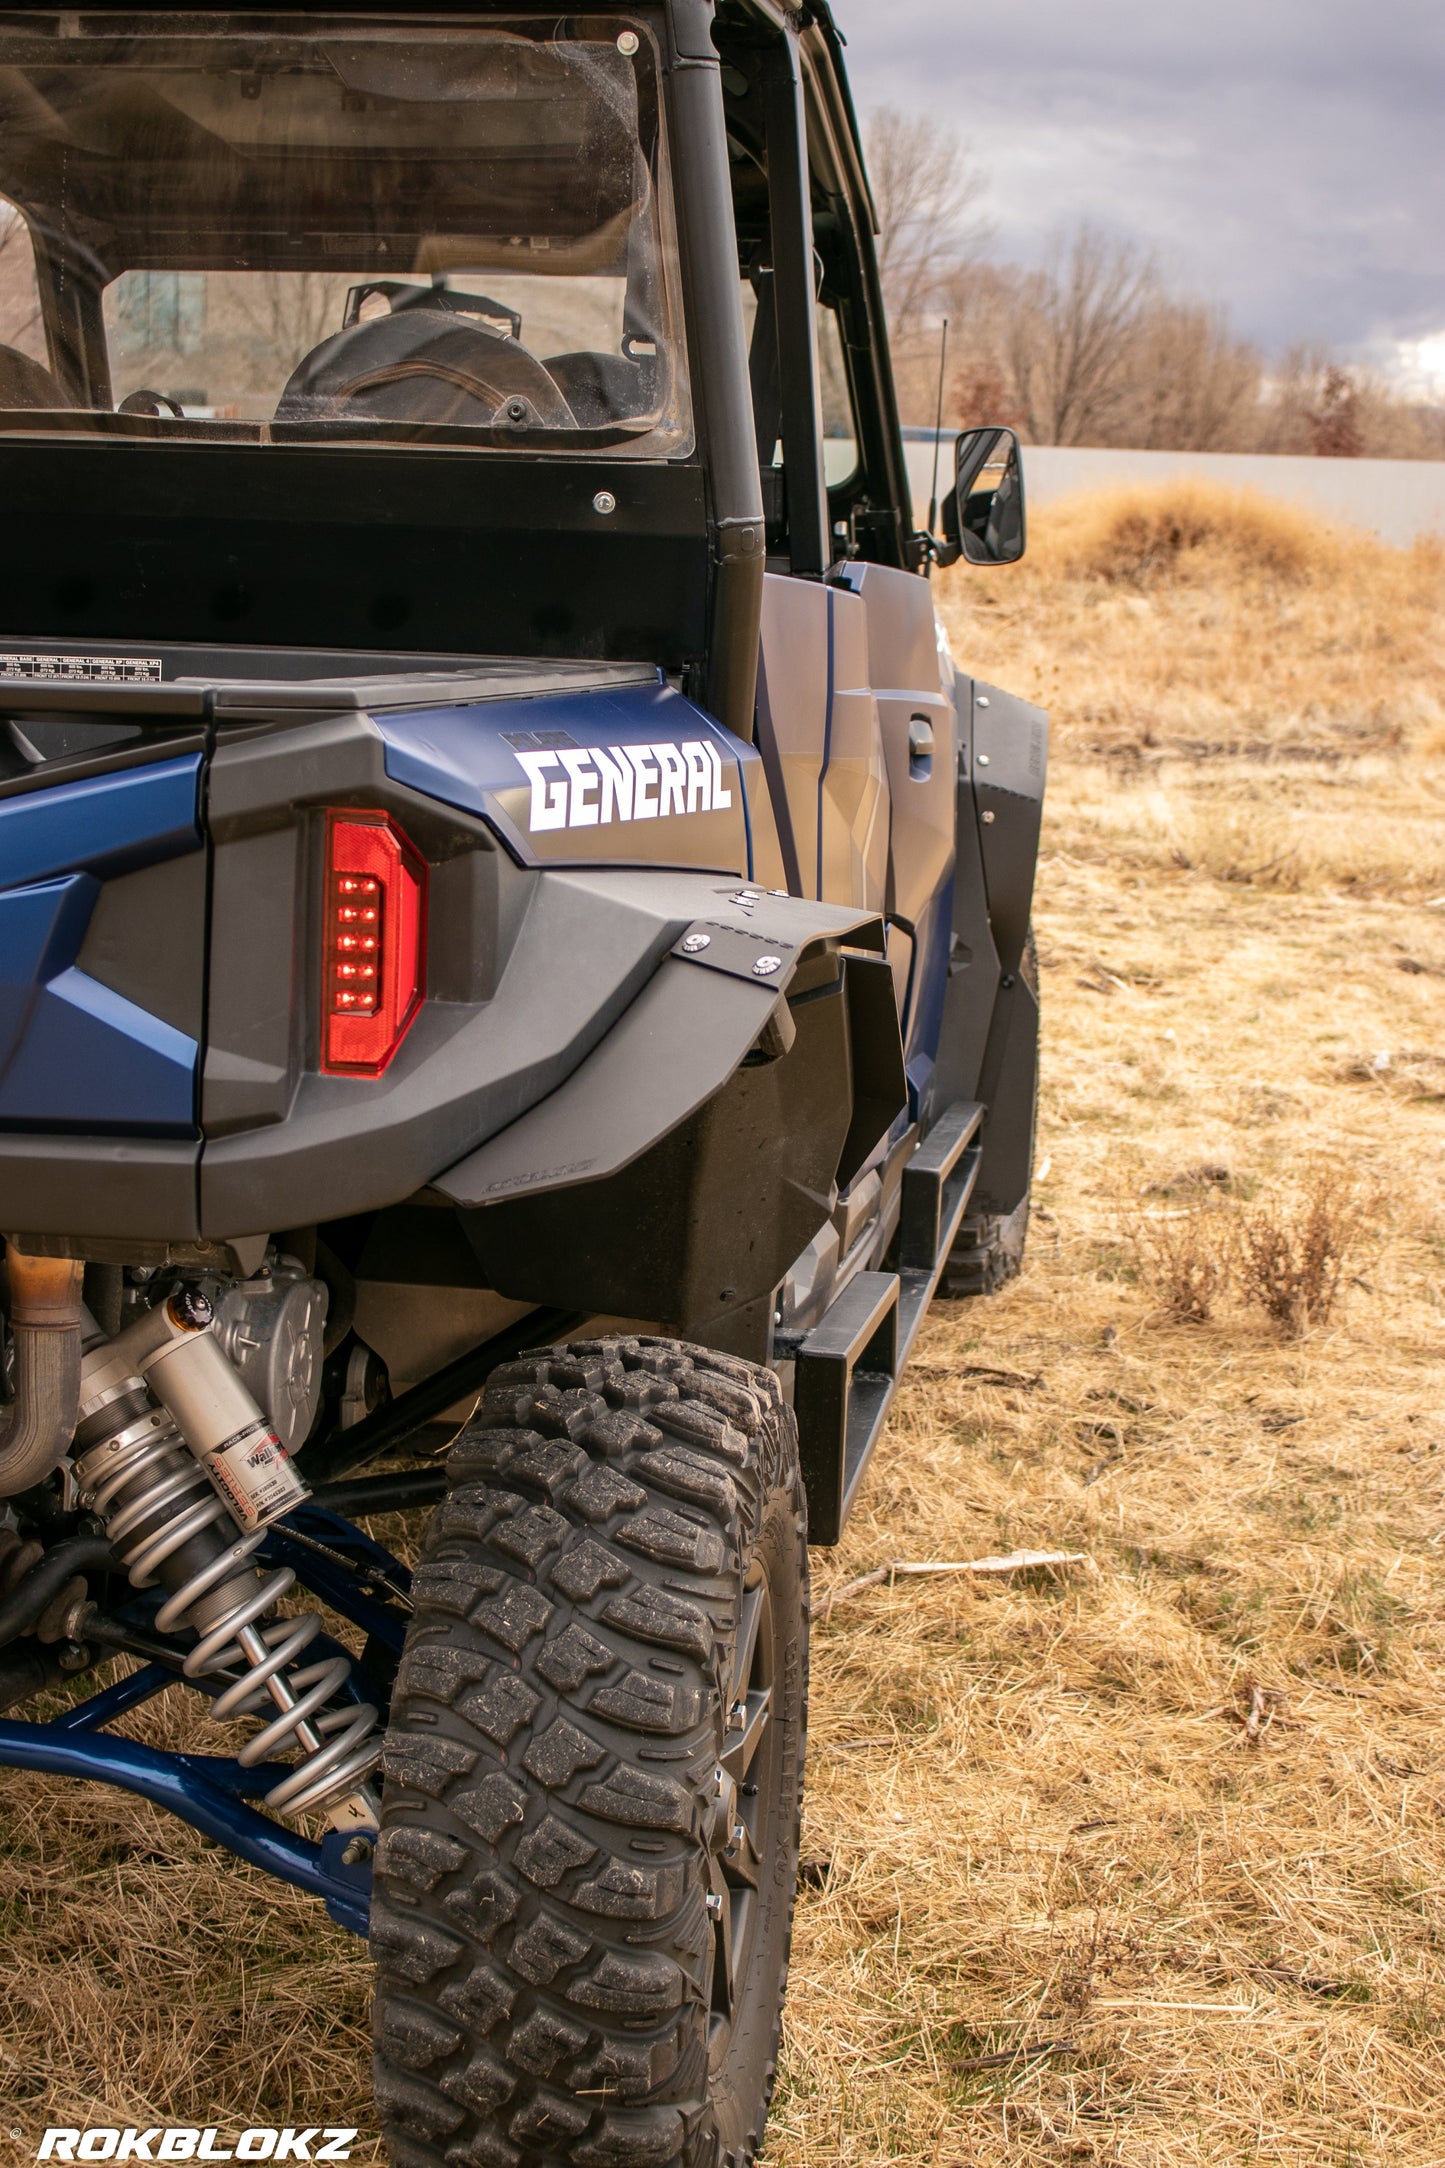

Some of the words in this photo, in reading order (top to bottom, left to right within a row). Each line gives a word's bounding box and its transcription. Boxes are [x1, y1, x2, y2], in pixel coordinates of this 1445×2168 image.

[514, 740, 731, 832] GENERAL
[208, 1463, 248, 1521] VELOCITY
[213, 1457, 255, 1518] SERIES
